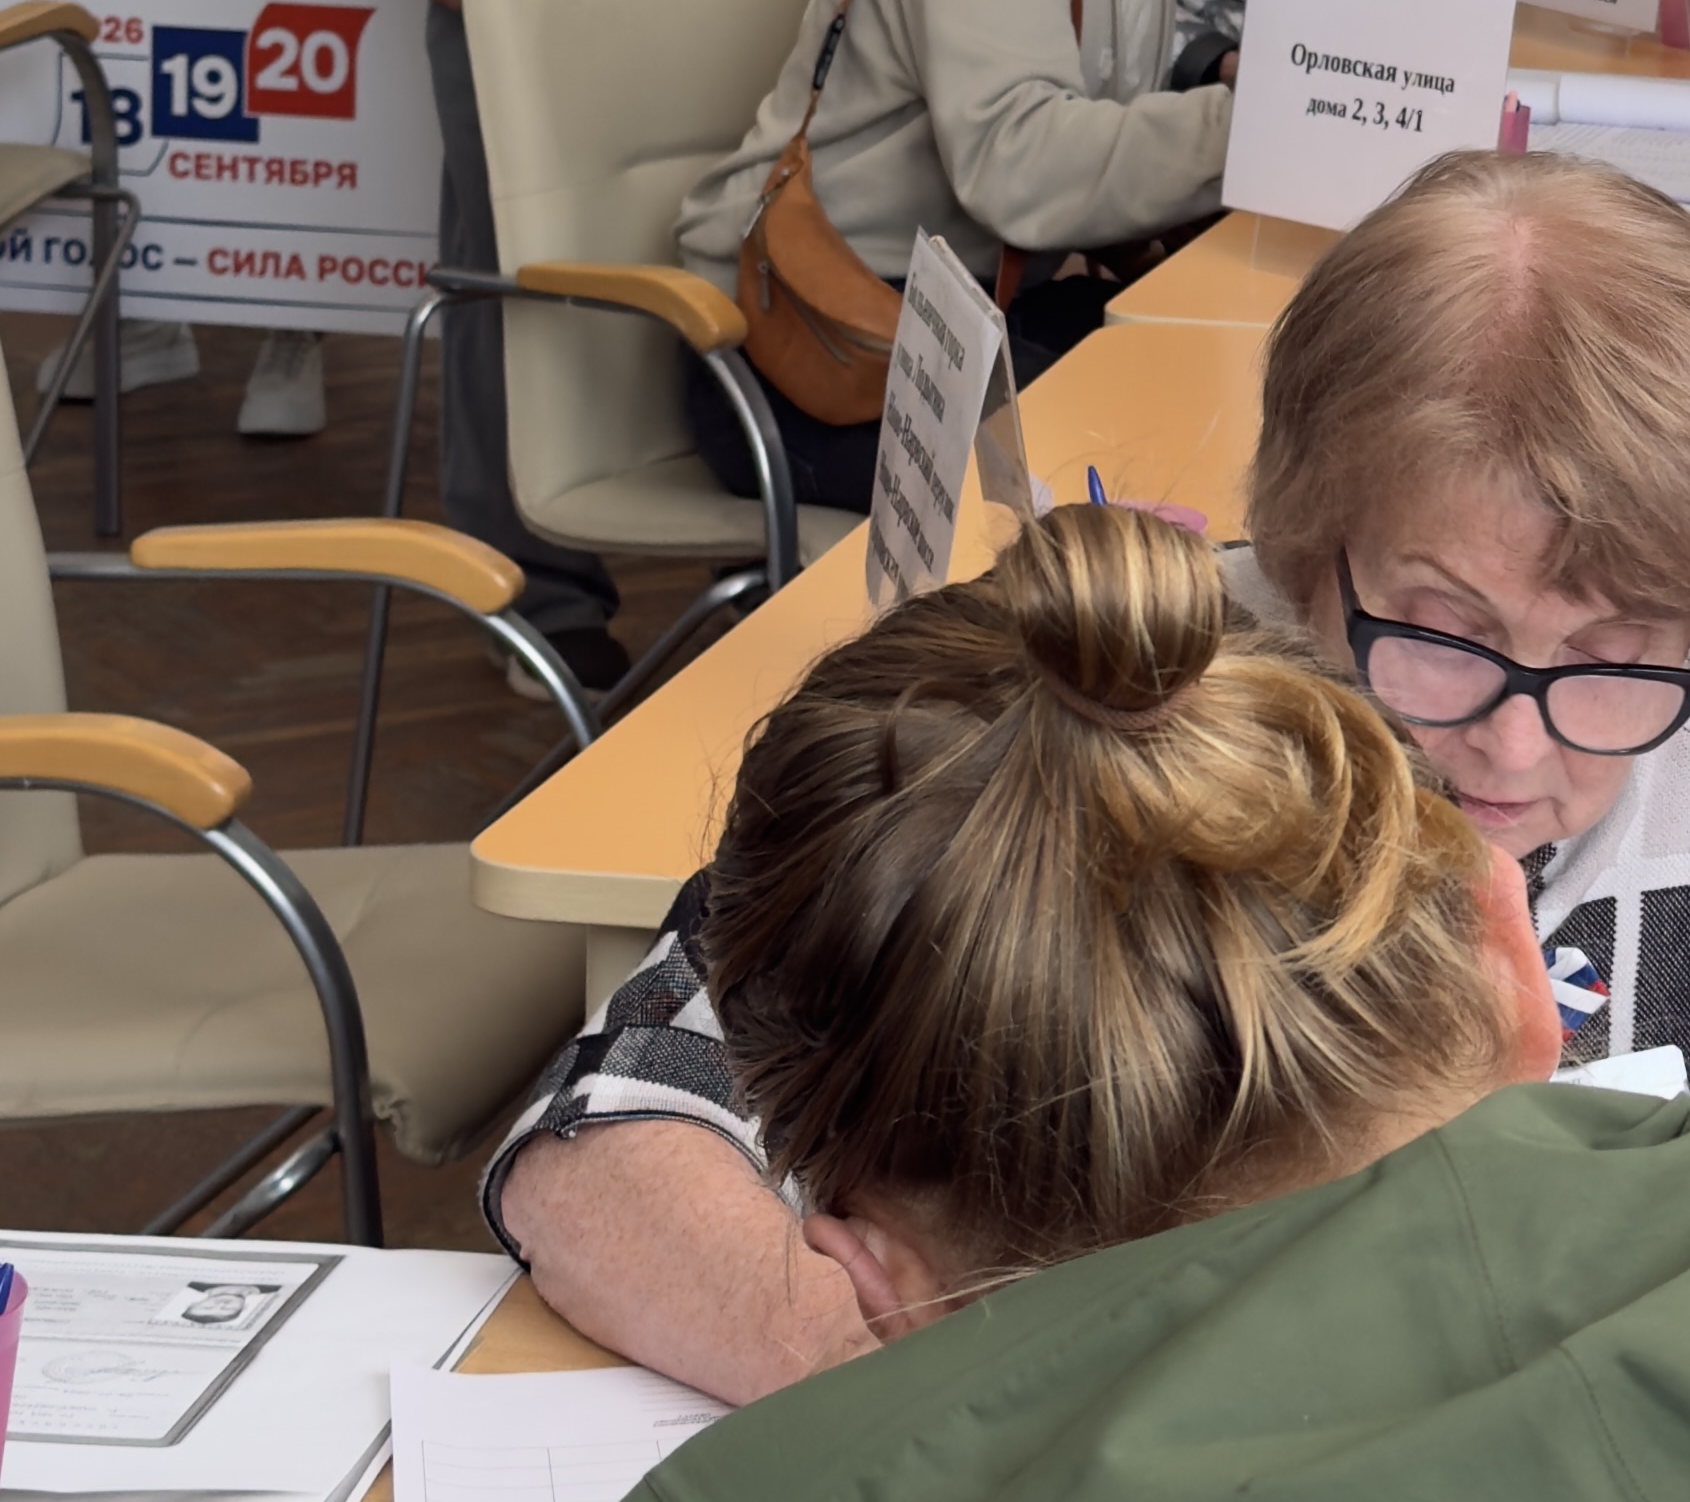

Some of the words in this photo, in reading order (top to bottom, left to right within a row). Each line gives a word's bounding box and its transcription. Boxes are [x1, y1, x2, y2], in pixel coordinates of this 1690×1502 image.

[98, 17, 143, 45] 26
[160, 54, 238, 120] 19
[255, 28, 349, 94] 20
[1291, 43, 1397, 83] Орловская
[1402, 70, 1455, 95] улица
[1306, 98, 1347, 117] дома
[1352, 98, 1367, 126] 2,
[1373, 102, 1389, 130] 3,
[1396, 107, 1423, 132] 4/1
[169, 150, 358, 189] СЕНТЯБРЯ
[45, 236, 163, 269] ГООС
[208, 248, 306, 280] СИЛА
